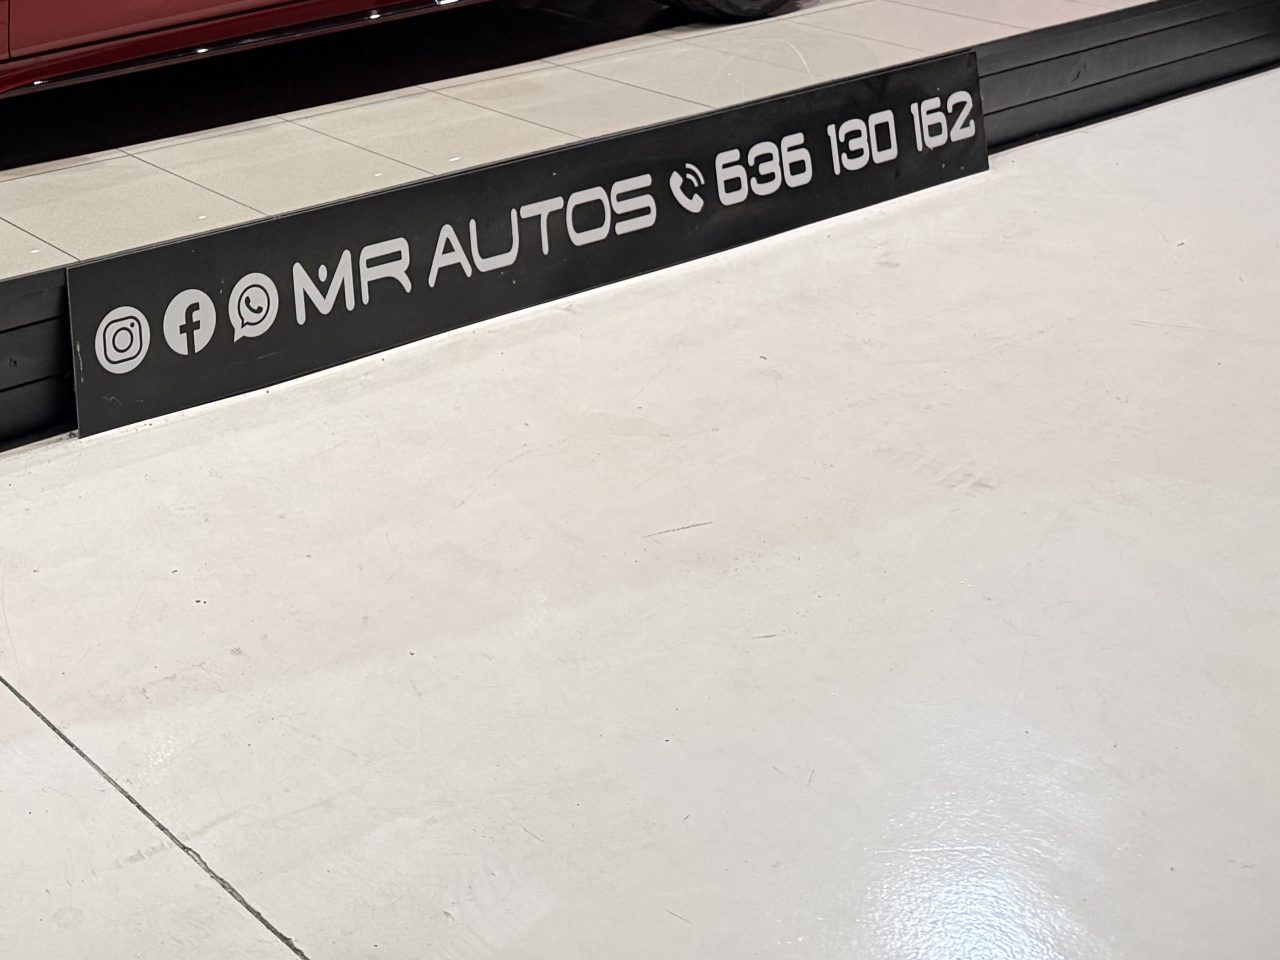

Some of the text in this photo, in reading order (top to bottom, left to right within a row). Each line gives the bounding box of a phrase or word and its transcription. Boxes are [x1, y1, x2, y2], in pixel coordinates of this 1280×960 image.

[292, 237, 412, 326] MR
[428, 173, 657, 288] AUTOS
[715, 132, 813, 207] 636
[827, 109, 898, 176] 130
[910, 90, 976, 152] 162
